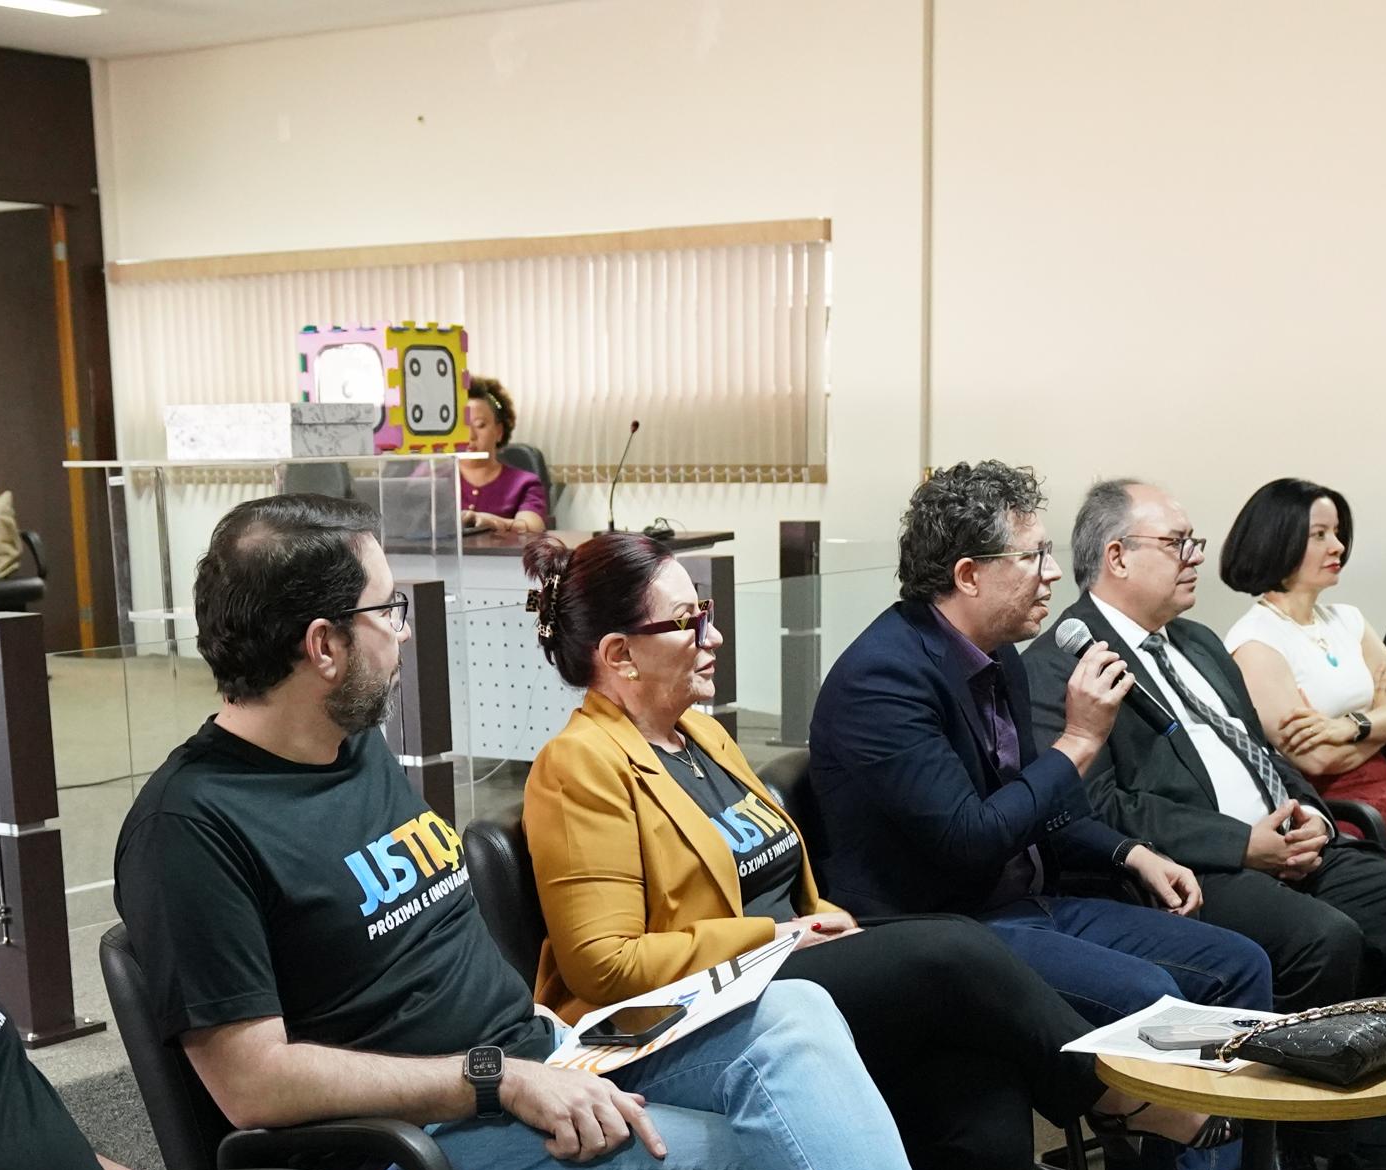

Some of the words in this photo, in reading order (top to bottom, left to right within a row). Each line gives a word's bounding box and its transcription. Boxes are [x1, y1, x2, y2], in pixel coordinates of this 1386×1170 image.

[738, 850, 769, 878] ÓXIMA
[367, 898, 423, 941] PRÓXIMA
[421, 892, 431, 908] E
